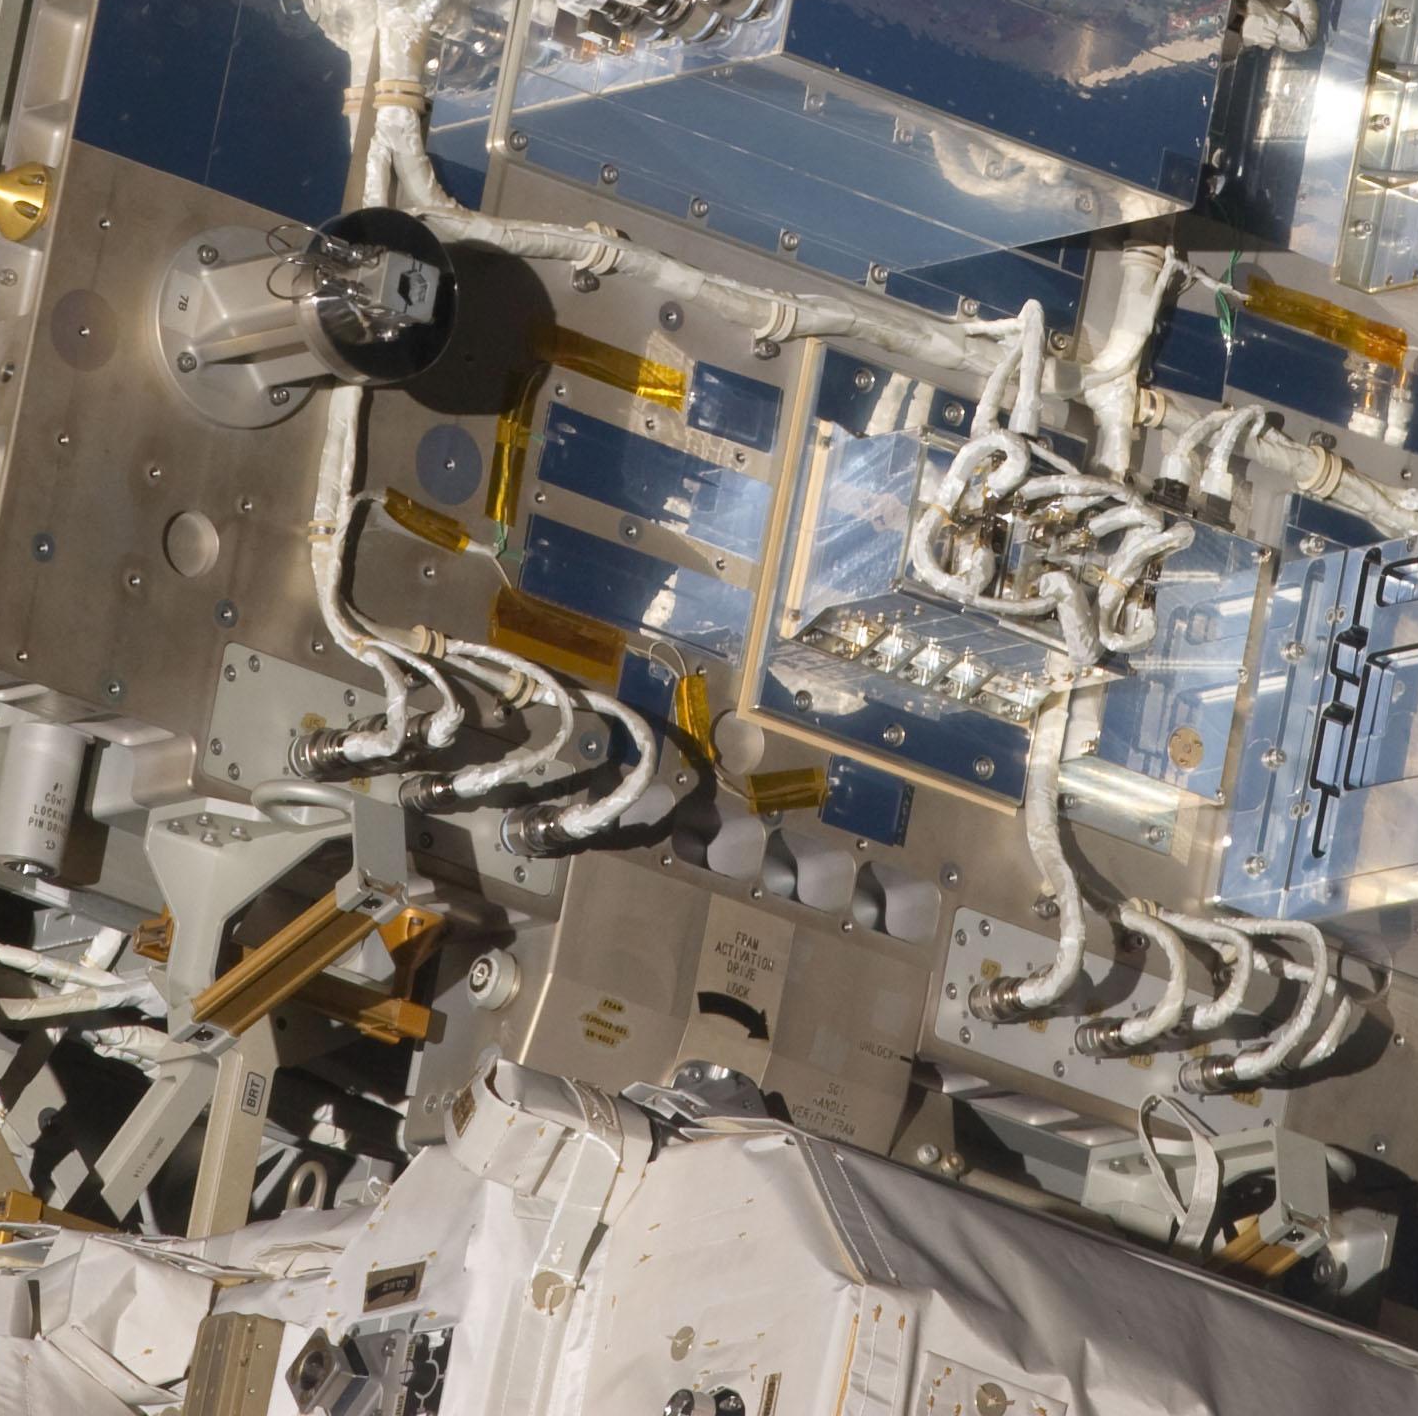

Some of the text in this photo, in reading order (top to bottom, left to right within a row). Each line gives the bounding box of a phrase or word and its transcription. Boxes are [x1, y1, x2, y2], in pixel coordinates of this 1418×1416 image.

[177, 294, 189, 311] 7B
[34, 804, 69, 823] LOCKIN
[734, 931, 759, 951] FRAM
[715, 940, 775, 973] ACTIVATION
[726, 959, 757, 983] DRIVE
[726, 980, 751, 1000] LOCK
[246, 1079, 261, 1108] BRT
